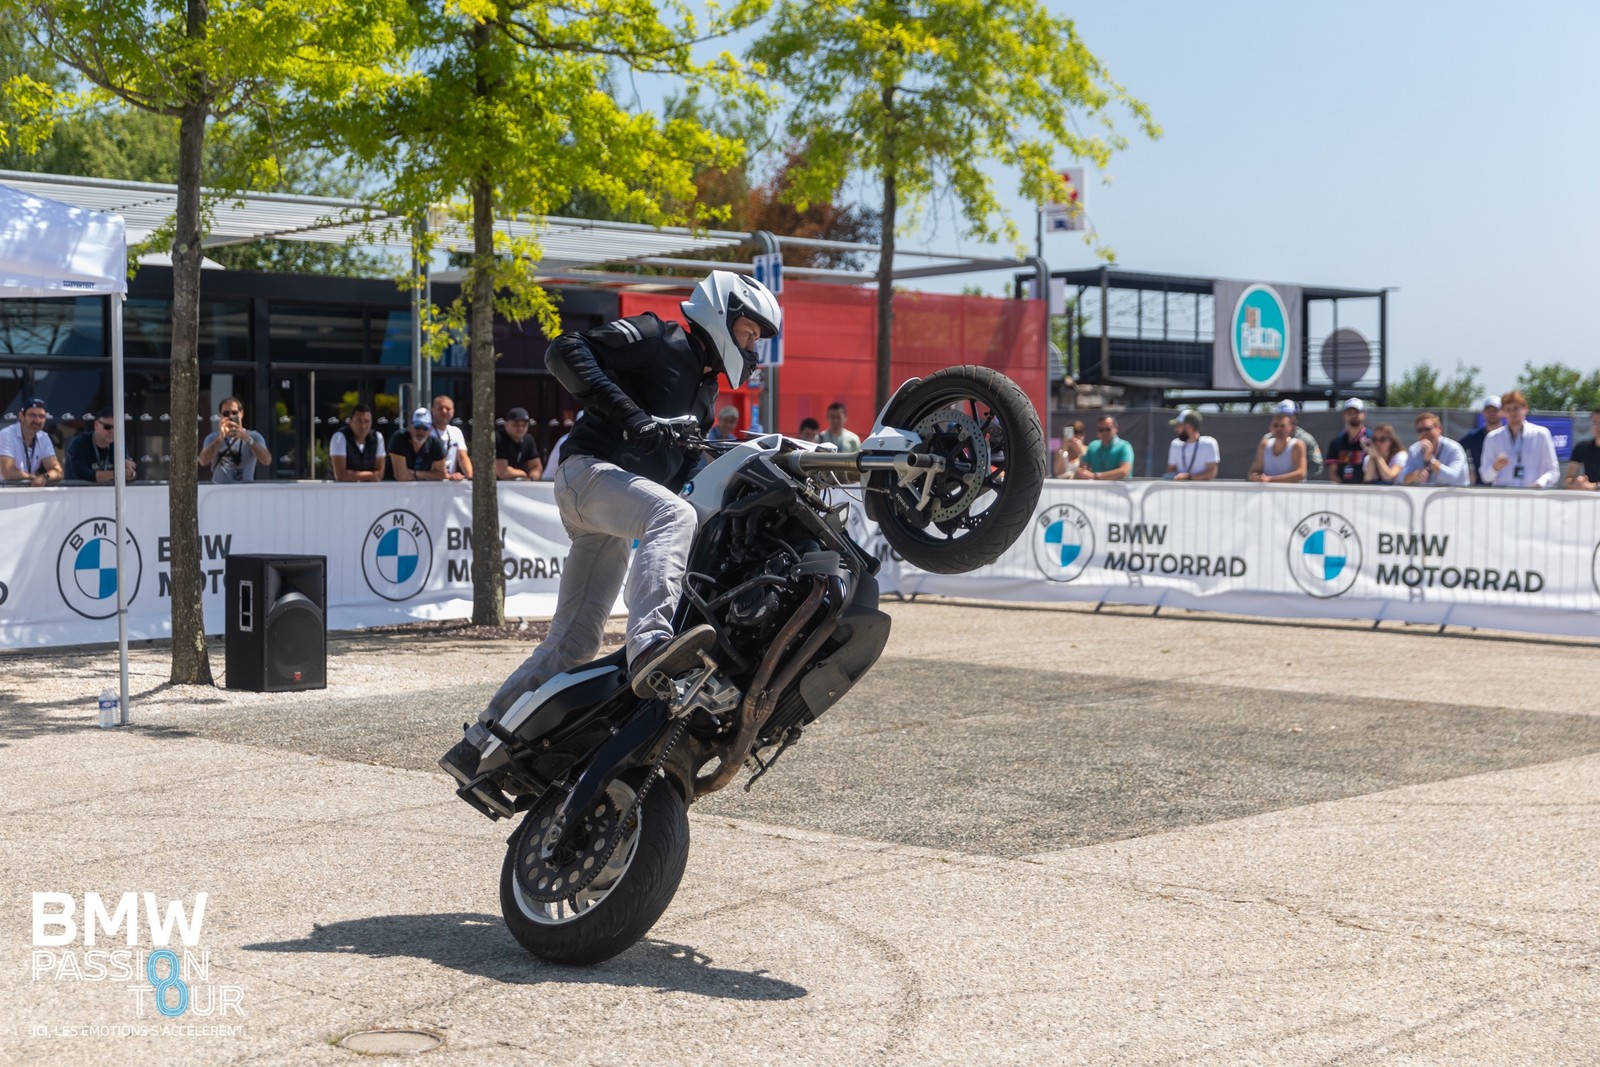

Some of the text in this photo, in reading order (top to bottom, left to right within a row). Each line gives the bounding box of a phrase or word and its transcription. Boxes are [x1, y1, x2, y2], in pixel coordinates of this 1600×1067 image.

[373, 513, 424, 540] BMW
[1040, 507, 1087, 529] BMW
[1298, 515, 1352, 539] BMW
[1107, 523, 1168, 545] BMW
[1378, 532, 1449, 557] BMW
[158, 534, 232, 563] BW
[447, 556, 568, 583] MORRA
[1103, 551, 1247, 578] MOTORRAD
[1376, 563, 1545, 593] MOTORRAD
